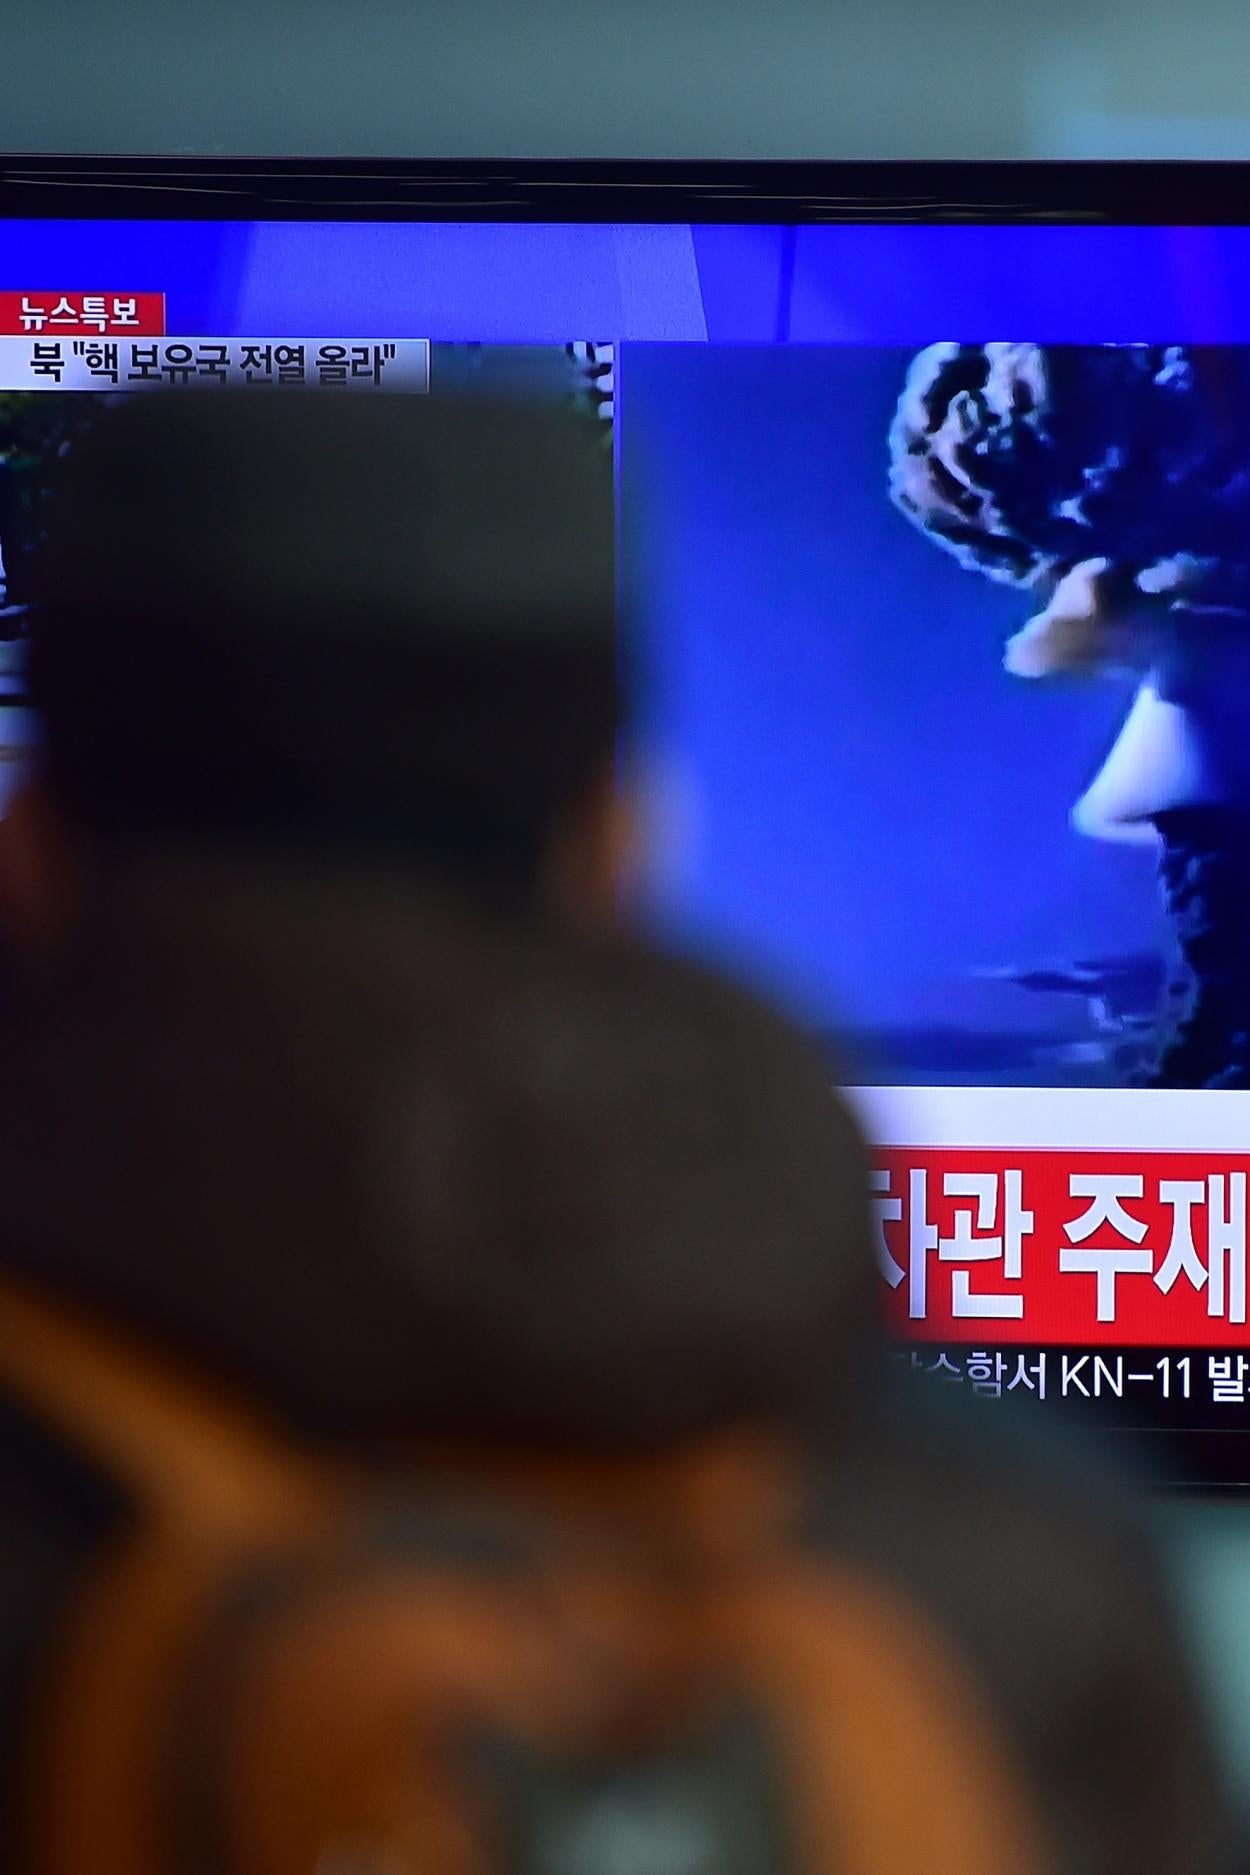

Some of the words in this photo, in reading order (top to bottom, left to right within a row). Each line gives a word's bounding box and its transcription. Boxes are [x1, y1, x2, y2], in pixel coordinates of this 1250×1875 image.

[18, 296, 140, 334] 뉴스특보
[30, 342, 65, 383] 북
[73, 341, 119, 384] "핵
[127, 344, 231, 385] 보유국
[240, 344, 306, 386] 전열
[315, 343, 396, 387] 올라"
[1059, 1171, 1247, 1324] 주재
[1061, 1354, 1191, 1399] KN-11
